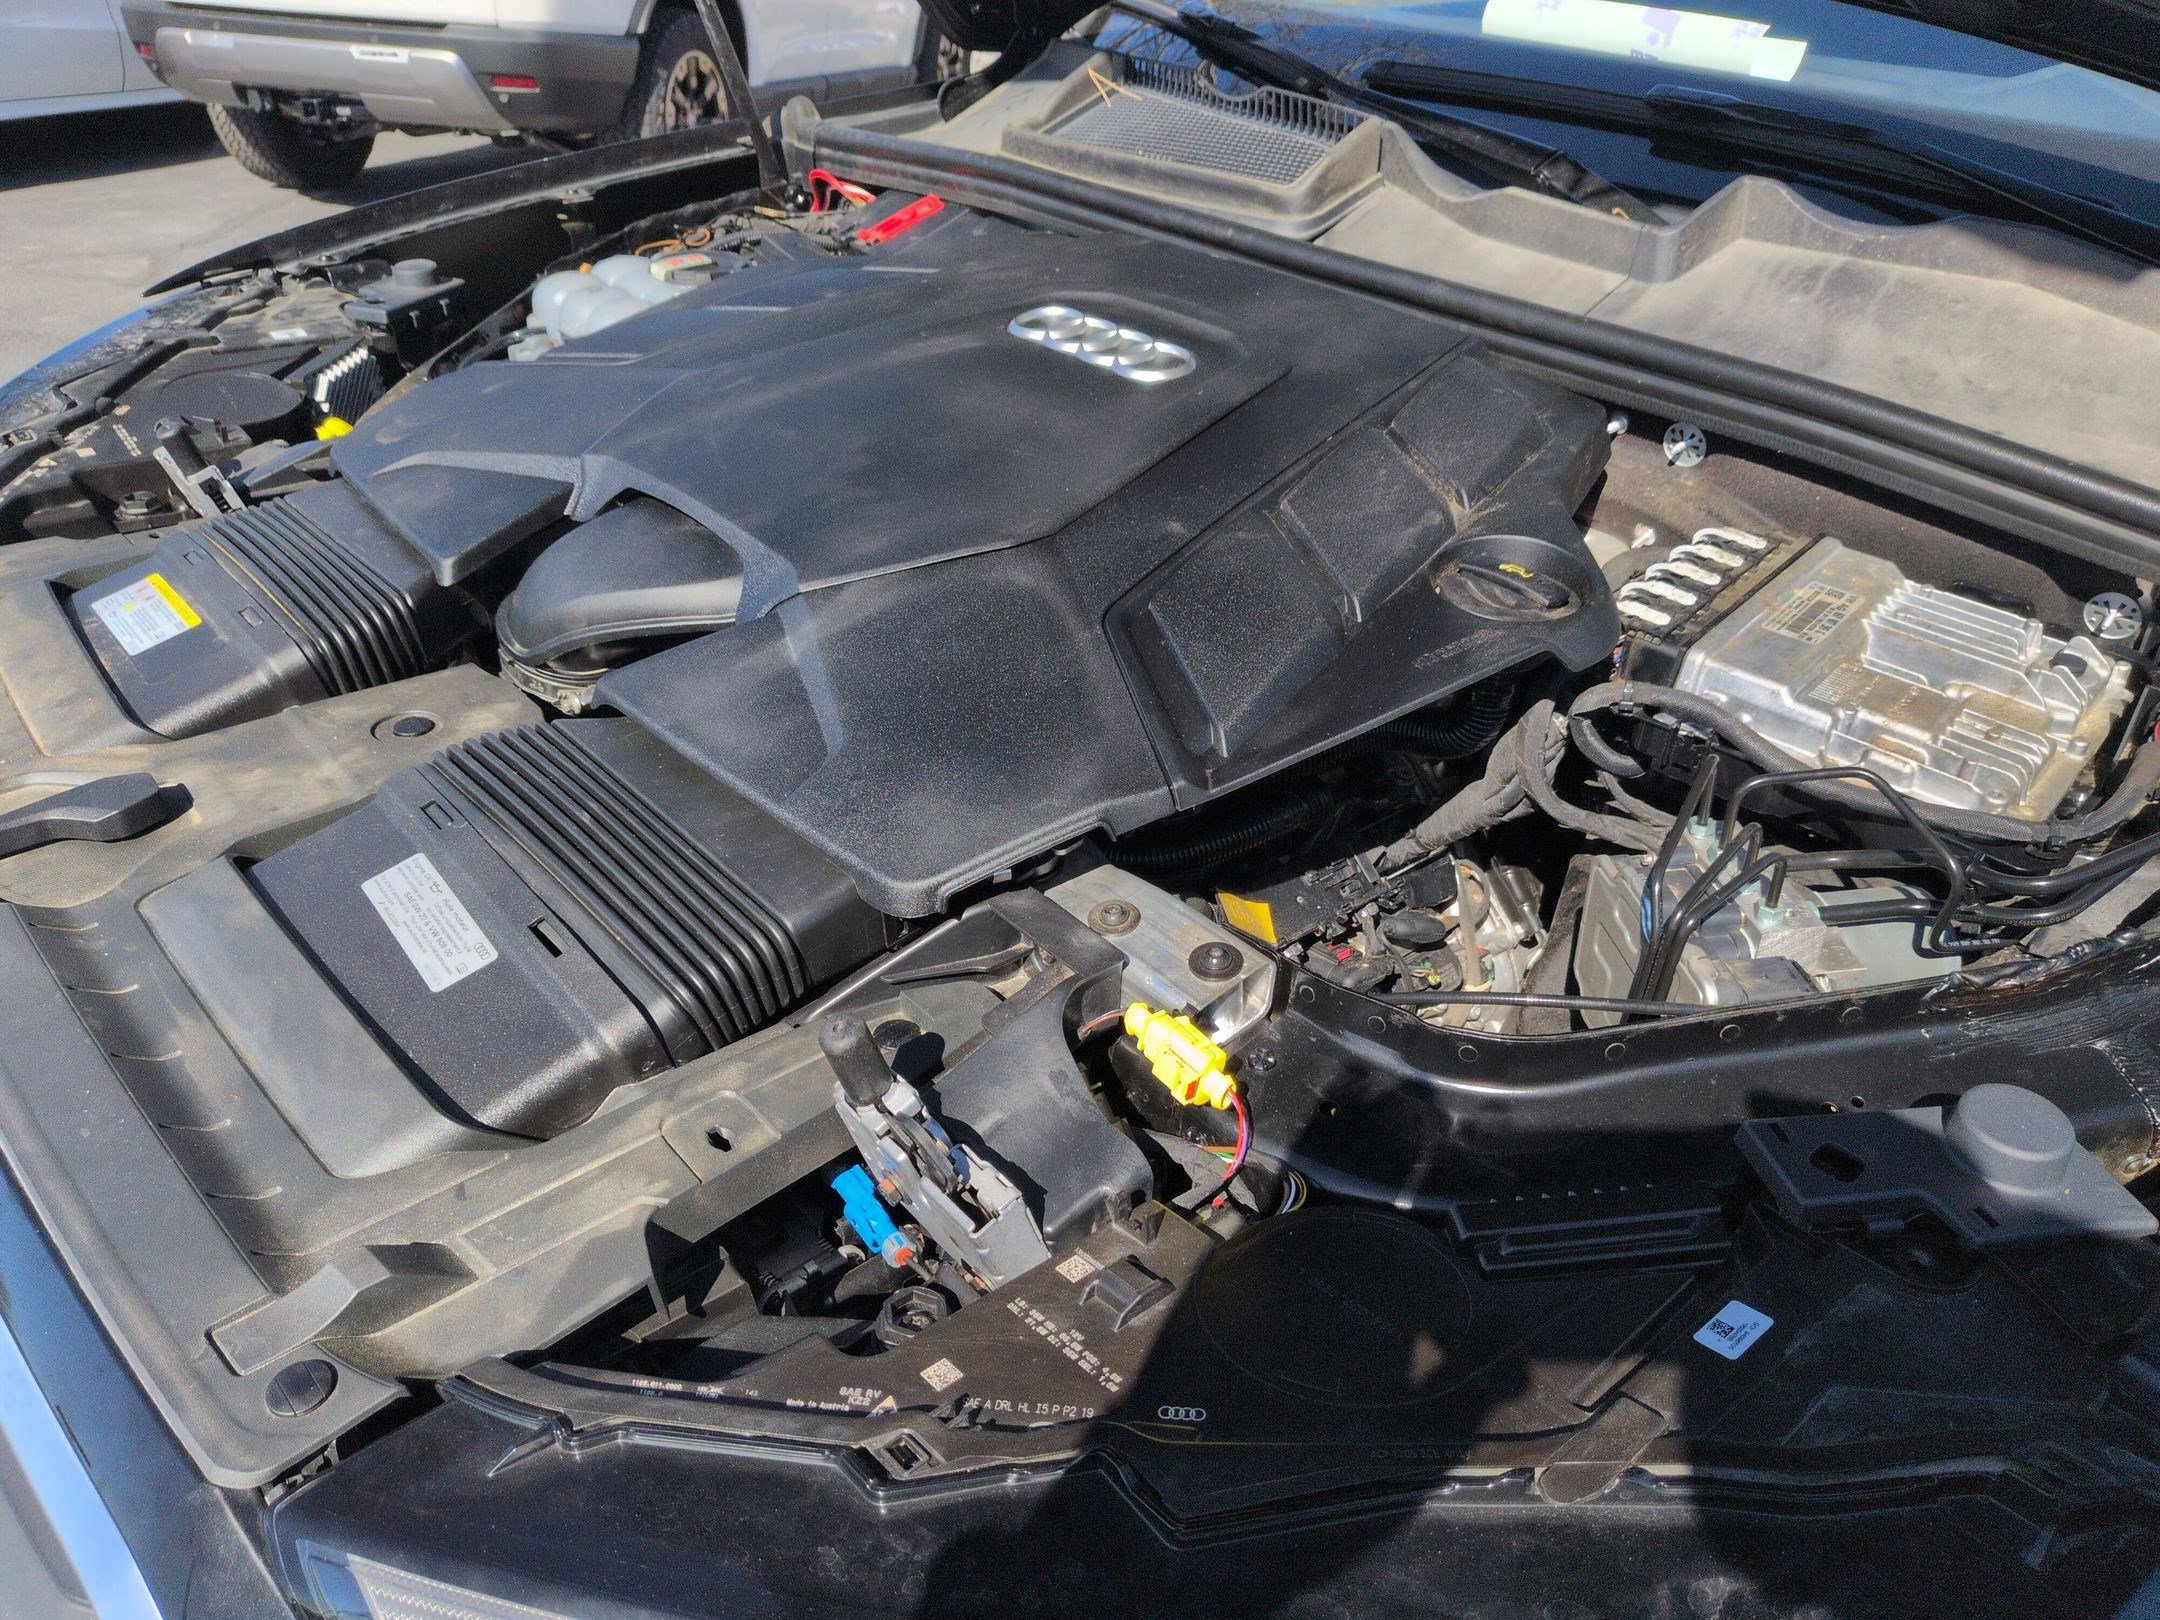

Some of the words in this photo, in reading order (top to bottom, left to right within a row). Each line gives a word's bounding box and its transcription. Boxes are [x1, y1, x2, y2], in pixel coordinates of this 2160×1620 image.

[404, 892, 415, 903] SAE
[428, 926, 439, 937] VW
[444, 948, 453, 957] 00
[839, 1386, 862, 1397] SAE
[819, 1401, 850, 1411] Austria
[984, 1399, 991, 1410] A
[995, 1399, 1013, 1412] DRL
[1018, 1402, 1030, 1413] HL
[1052, 1404, 1060, 1415] P
[1062, 1406, 1077, 1417] P2
[1082, 1408, 1094, 1418] 19
